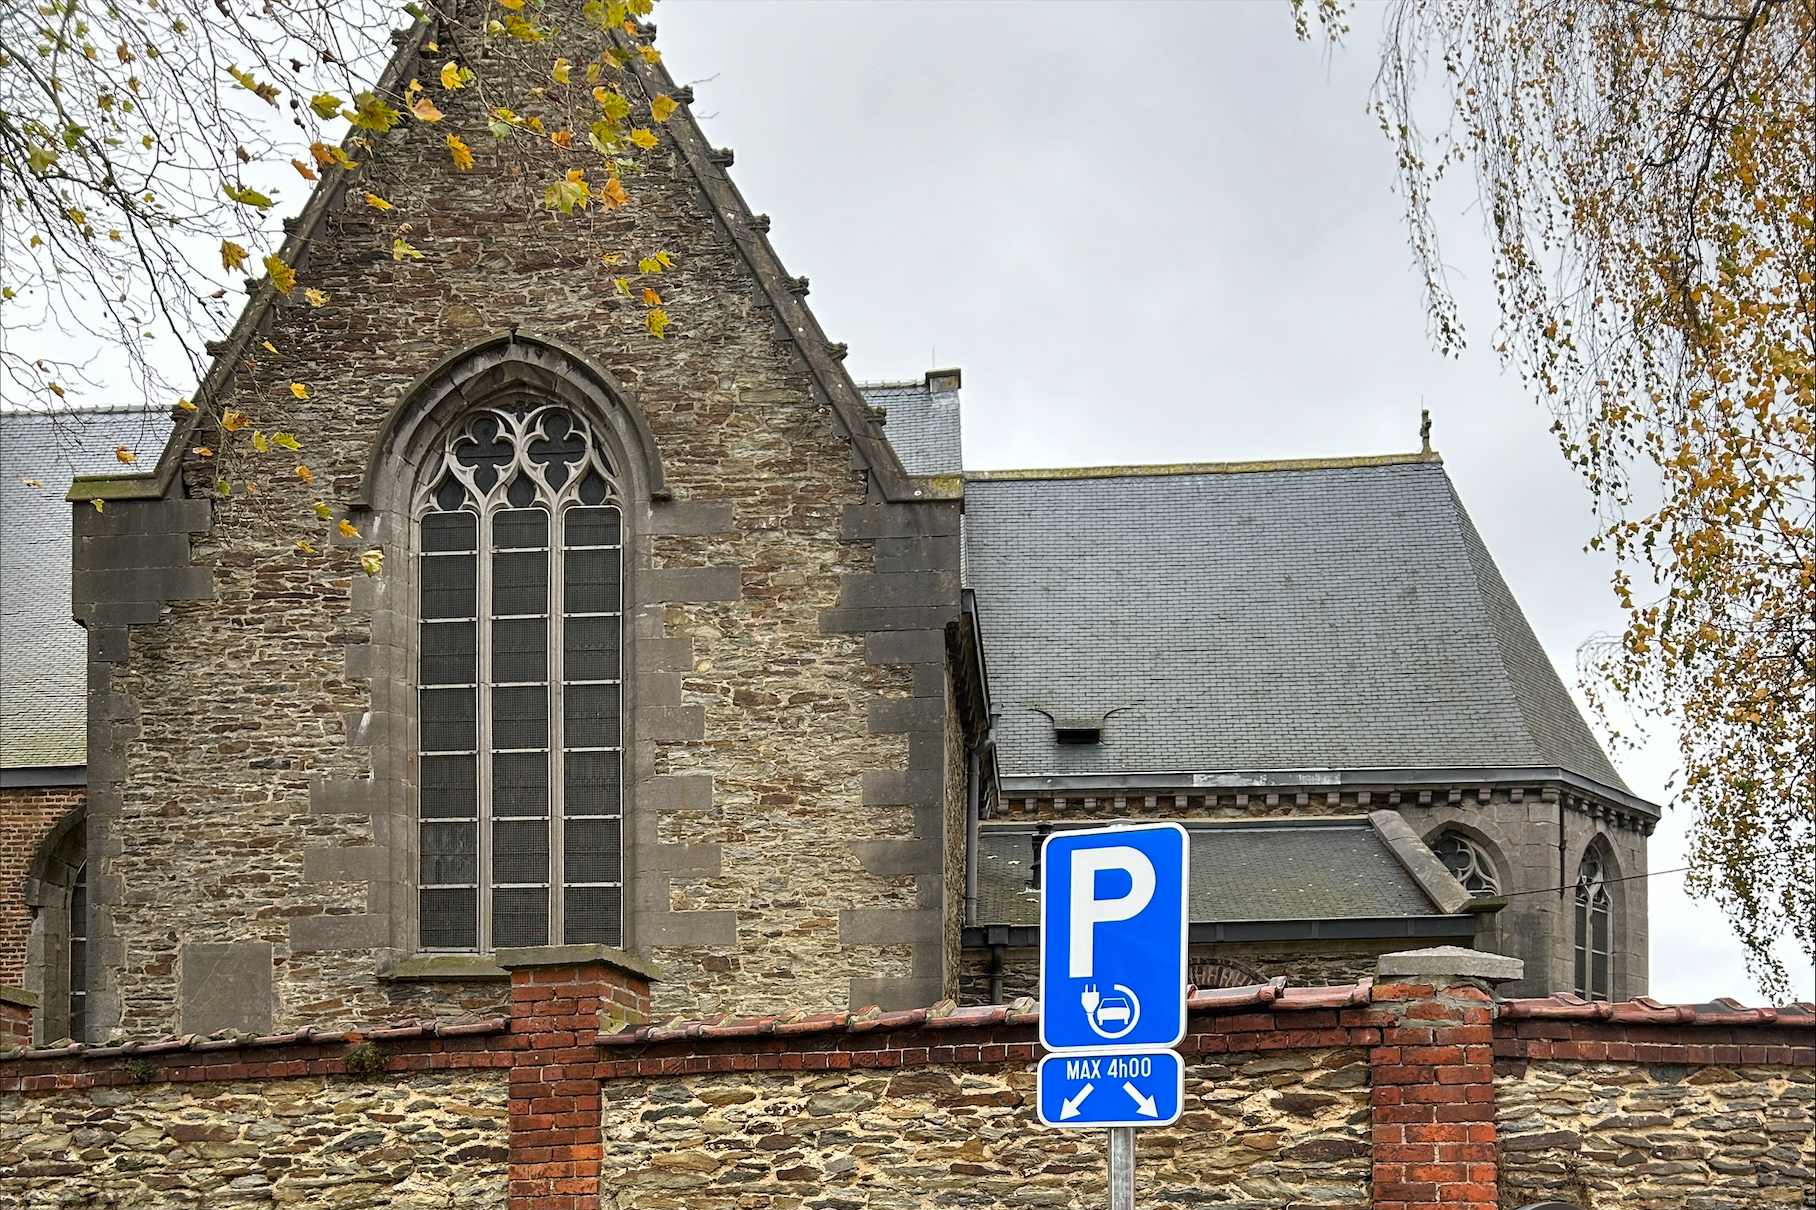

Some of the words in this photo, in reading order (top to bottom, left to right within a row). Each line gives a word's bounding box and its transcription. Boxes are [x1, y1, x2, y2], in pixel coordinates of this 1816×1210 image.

[1069, 846, 1156, 978] P
[1066, 1058, 1101, 1080] MAX
[1107, 1057, 1152, 1079] 4h00
